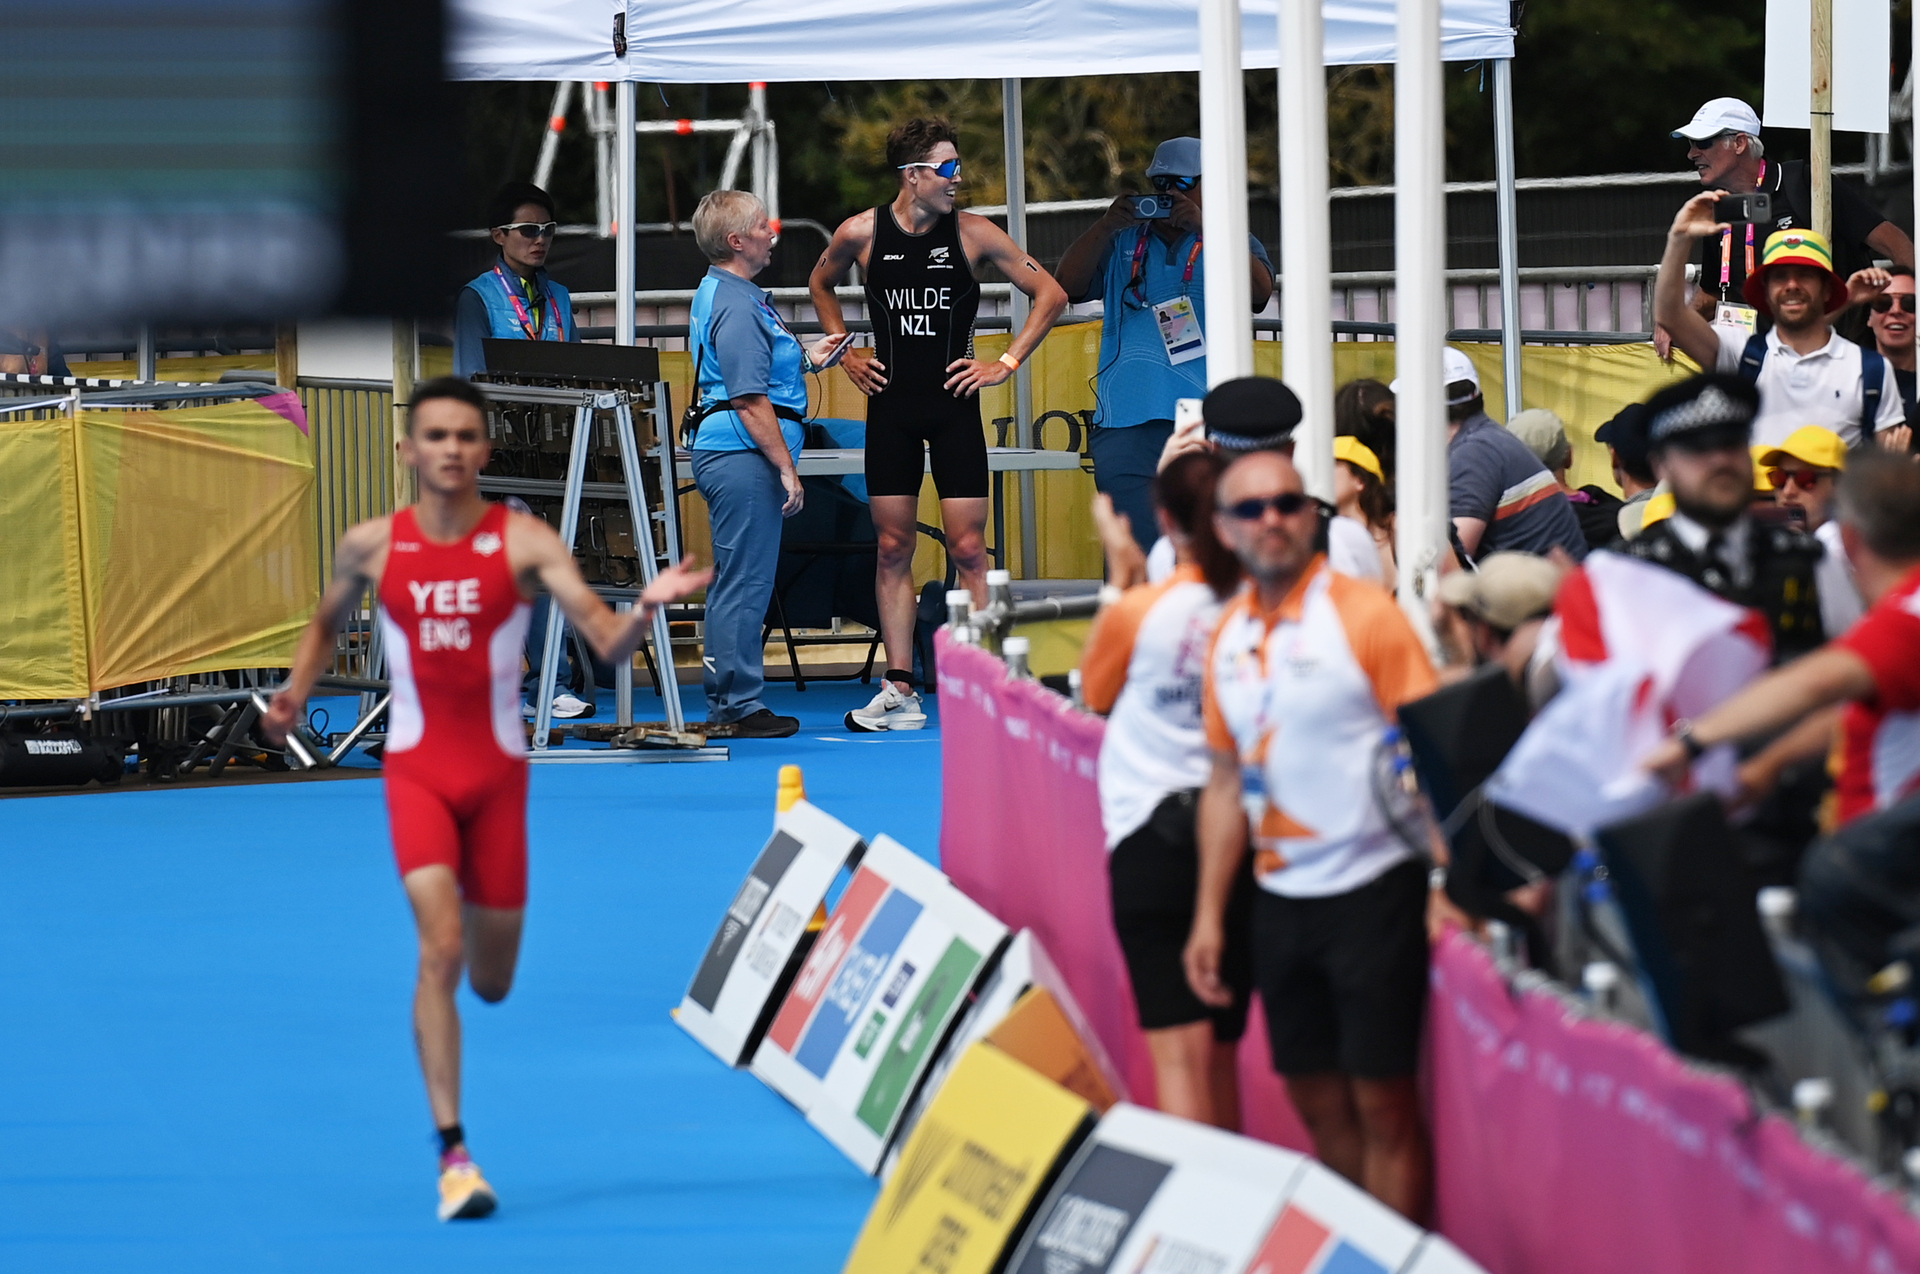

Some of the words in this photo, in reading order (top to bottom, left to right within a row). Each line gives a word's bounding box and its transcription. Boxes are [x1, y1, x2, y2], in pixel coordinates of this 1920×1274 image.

[1025, 261, 1039, 273] 1
[885, 287, 952, 310] WILDE
[900, 314, 937, 337] NZL
[408, 577, 482, 615] YEE
[419, 617, 472, 652] ENG
